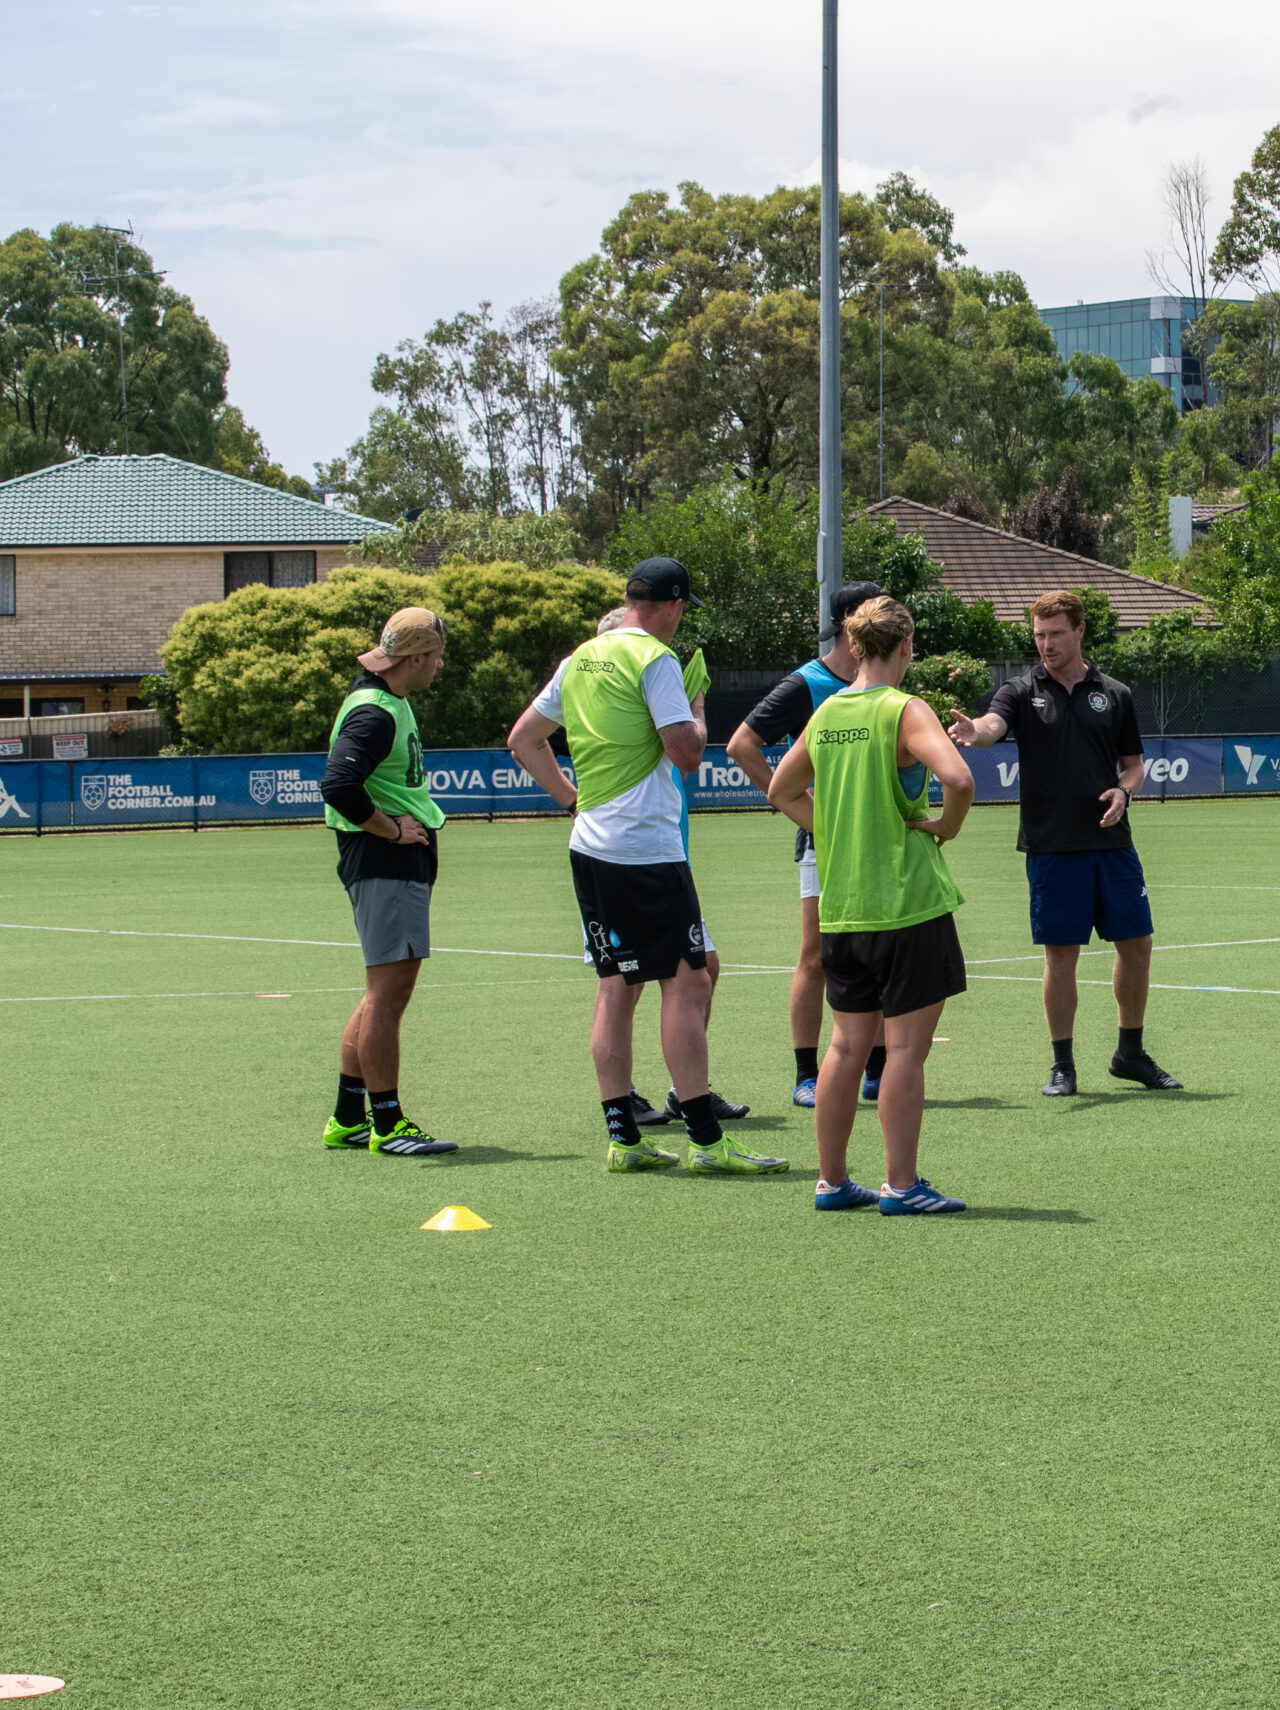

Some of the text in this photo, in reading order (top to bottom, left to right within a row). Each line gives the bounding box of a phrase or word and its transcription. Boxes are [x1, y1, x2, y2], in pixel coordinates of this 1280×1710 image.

[576, 658, 615, 674] Kappa
[816, 728, 869, 745] Kappa
[108, 774, 132, 786] THE
[277, 769, 300, 781] THE
[108, 785, 173, 797] FOOTBALL
[277, 780, 322, 792] FOOTB
[693, 789, 766, 799] www.wholesaletro
[108, 795, 216, 810] CORNER.COM.AU
